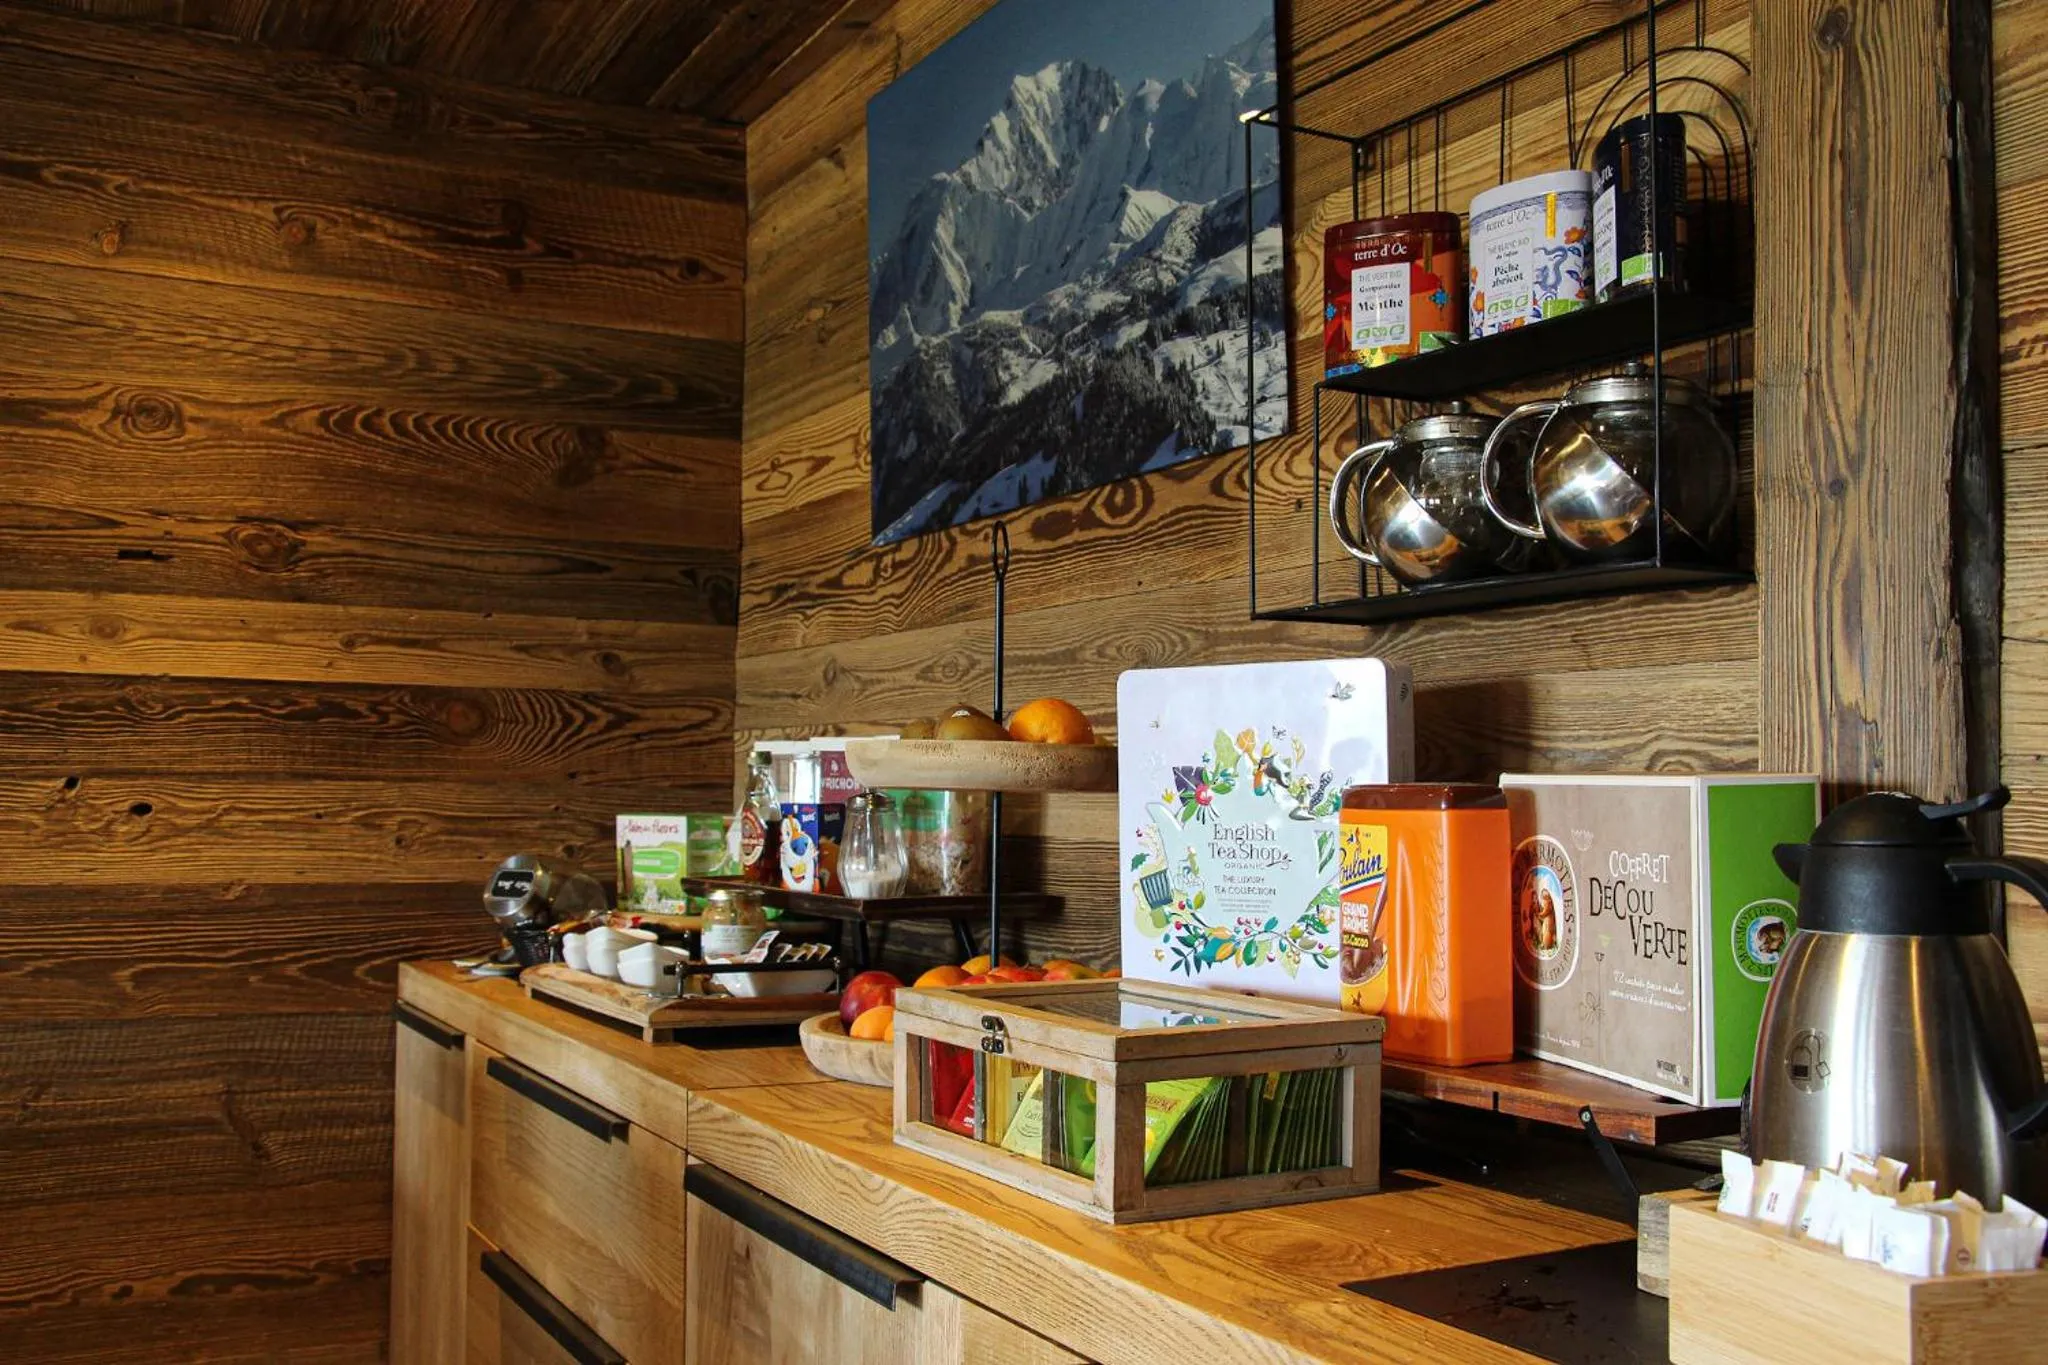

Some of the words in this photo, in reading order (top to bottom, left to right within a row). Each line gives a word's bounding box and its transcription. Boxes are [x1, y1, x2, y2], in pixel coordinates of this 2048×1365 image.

[1354, 250, 1378, 261] terre
[1358, 298, 1404, 312] Menthe
[1213, 823, 1277, 845] English
[1207, 842, 1237, 860] Tea
[1239, 843, 1282, 865] Shop
[1224, 862, 1265, 870] ORGANIC
[1609, 850, 1670, 884] COFFRET
[1228, 886, 1276, 896] COLLECTION
[1341, 902, 1369, 917] GRAND
[1628, 915, 1687, 966] VERTE
